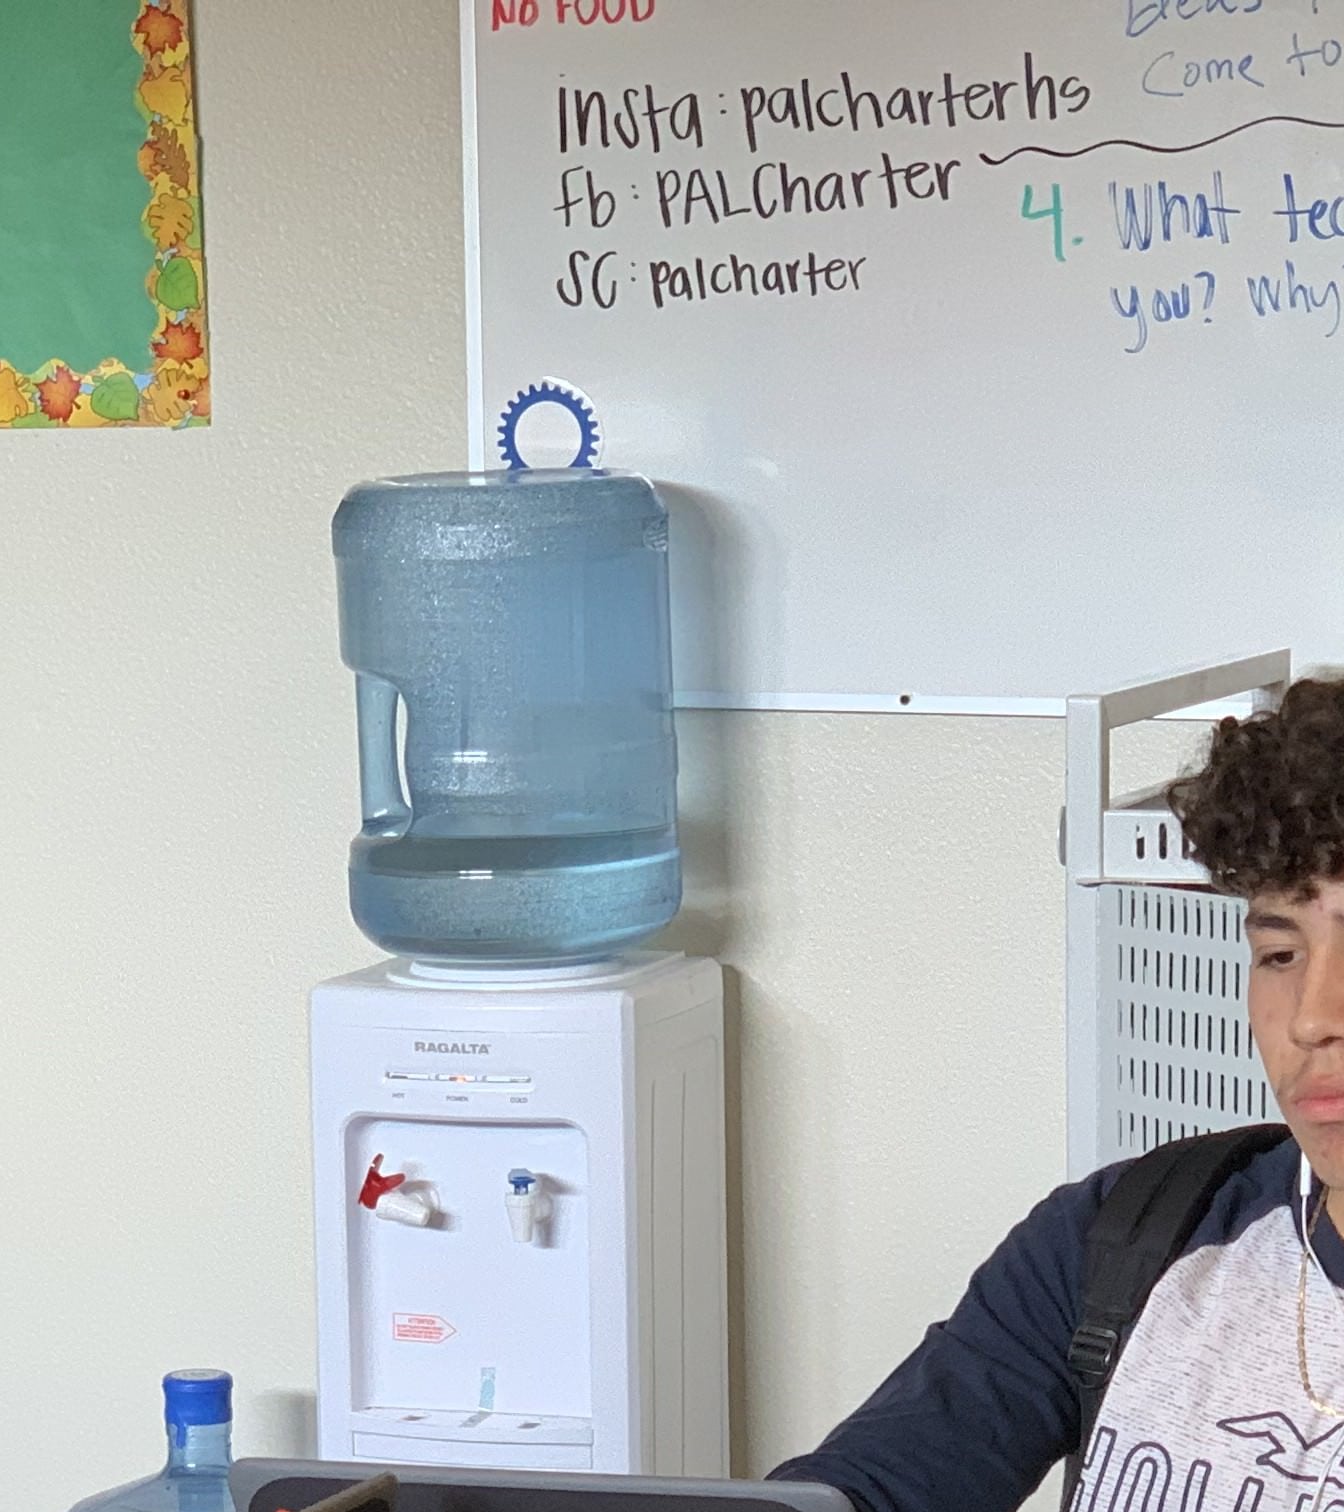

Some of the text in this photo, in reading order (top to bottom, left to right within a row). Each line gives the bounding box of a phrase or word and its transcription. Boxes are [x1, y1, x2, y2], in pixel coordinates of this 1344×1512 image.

[1286, 32, 1342, 77] to
[739, 52, 1092, 154] palcharterhs
[656, 153, 962, 229] PALCharter
[1020, 182, 1084, 263] 4.
[1108, 169, 1242, 254] What
[649, 252, 867, 310] palcharter
[1112, 270, 1217, 354] you?
[413, 1041, 491, 1055] RAGALTA
